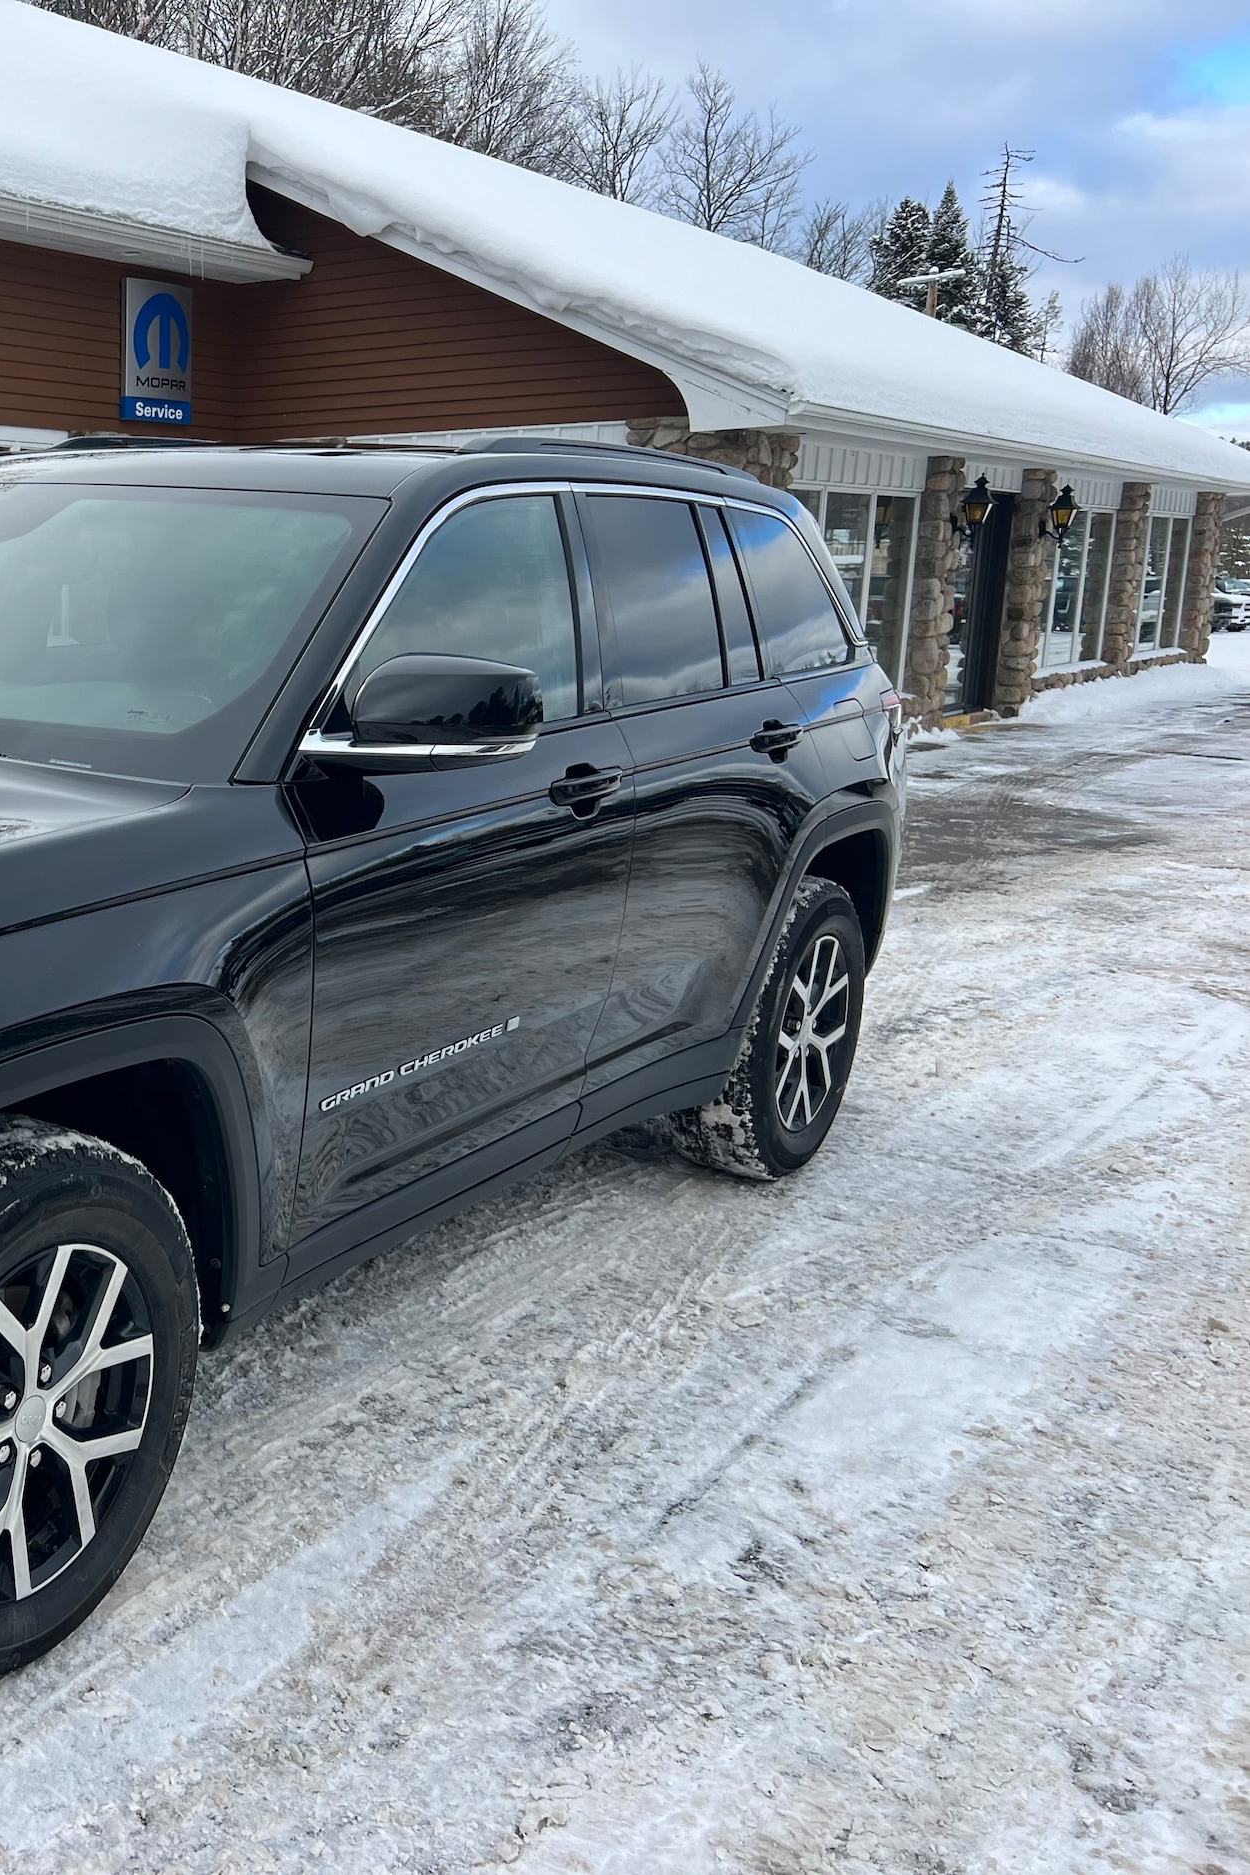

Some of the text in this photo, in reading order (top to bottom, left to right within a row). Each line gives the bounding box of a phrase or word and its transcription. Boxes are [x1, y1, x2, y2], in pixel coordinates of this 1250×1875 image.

[136, 375, 186, 391] MOPAR
[135, 401, 183, 420] Service
[319, 1023, 504, 1112] GRAND CHEROKEE
